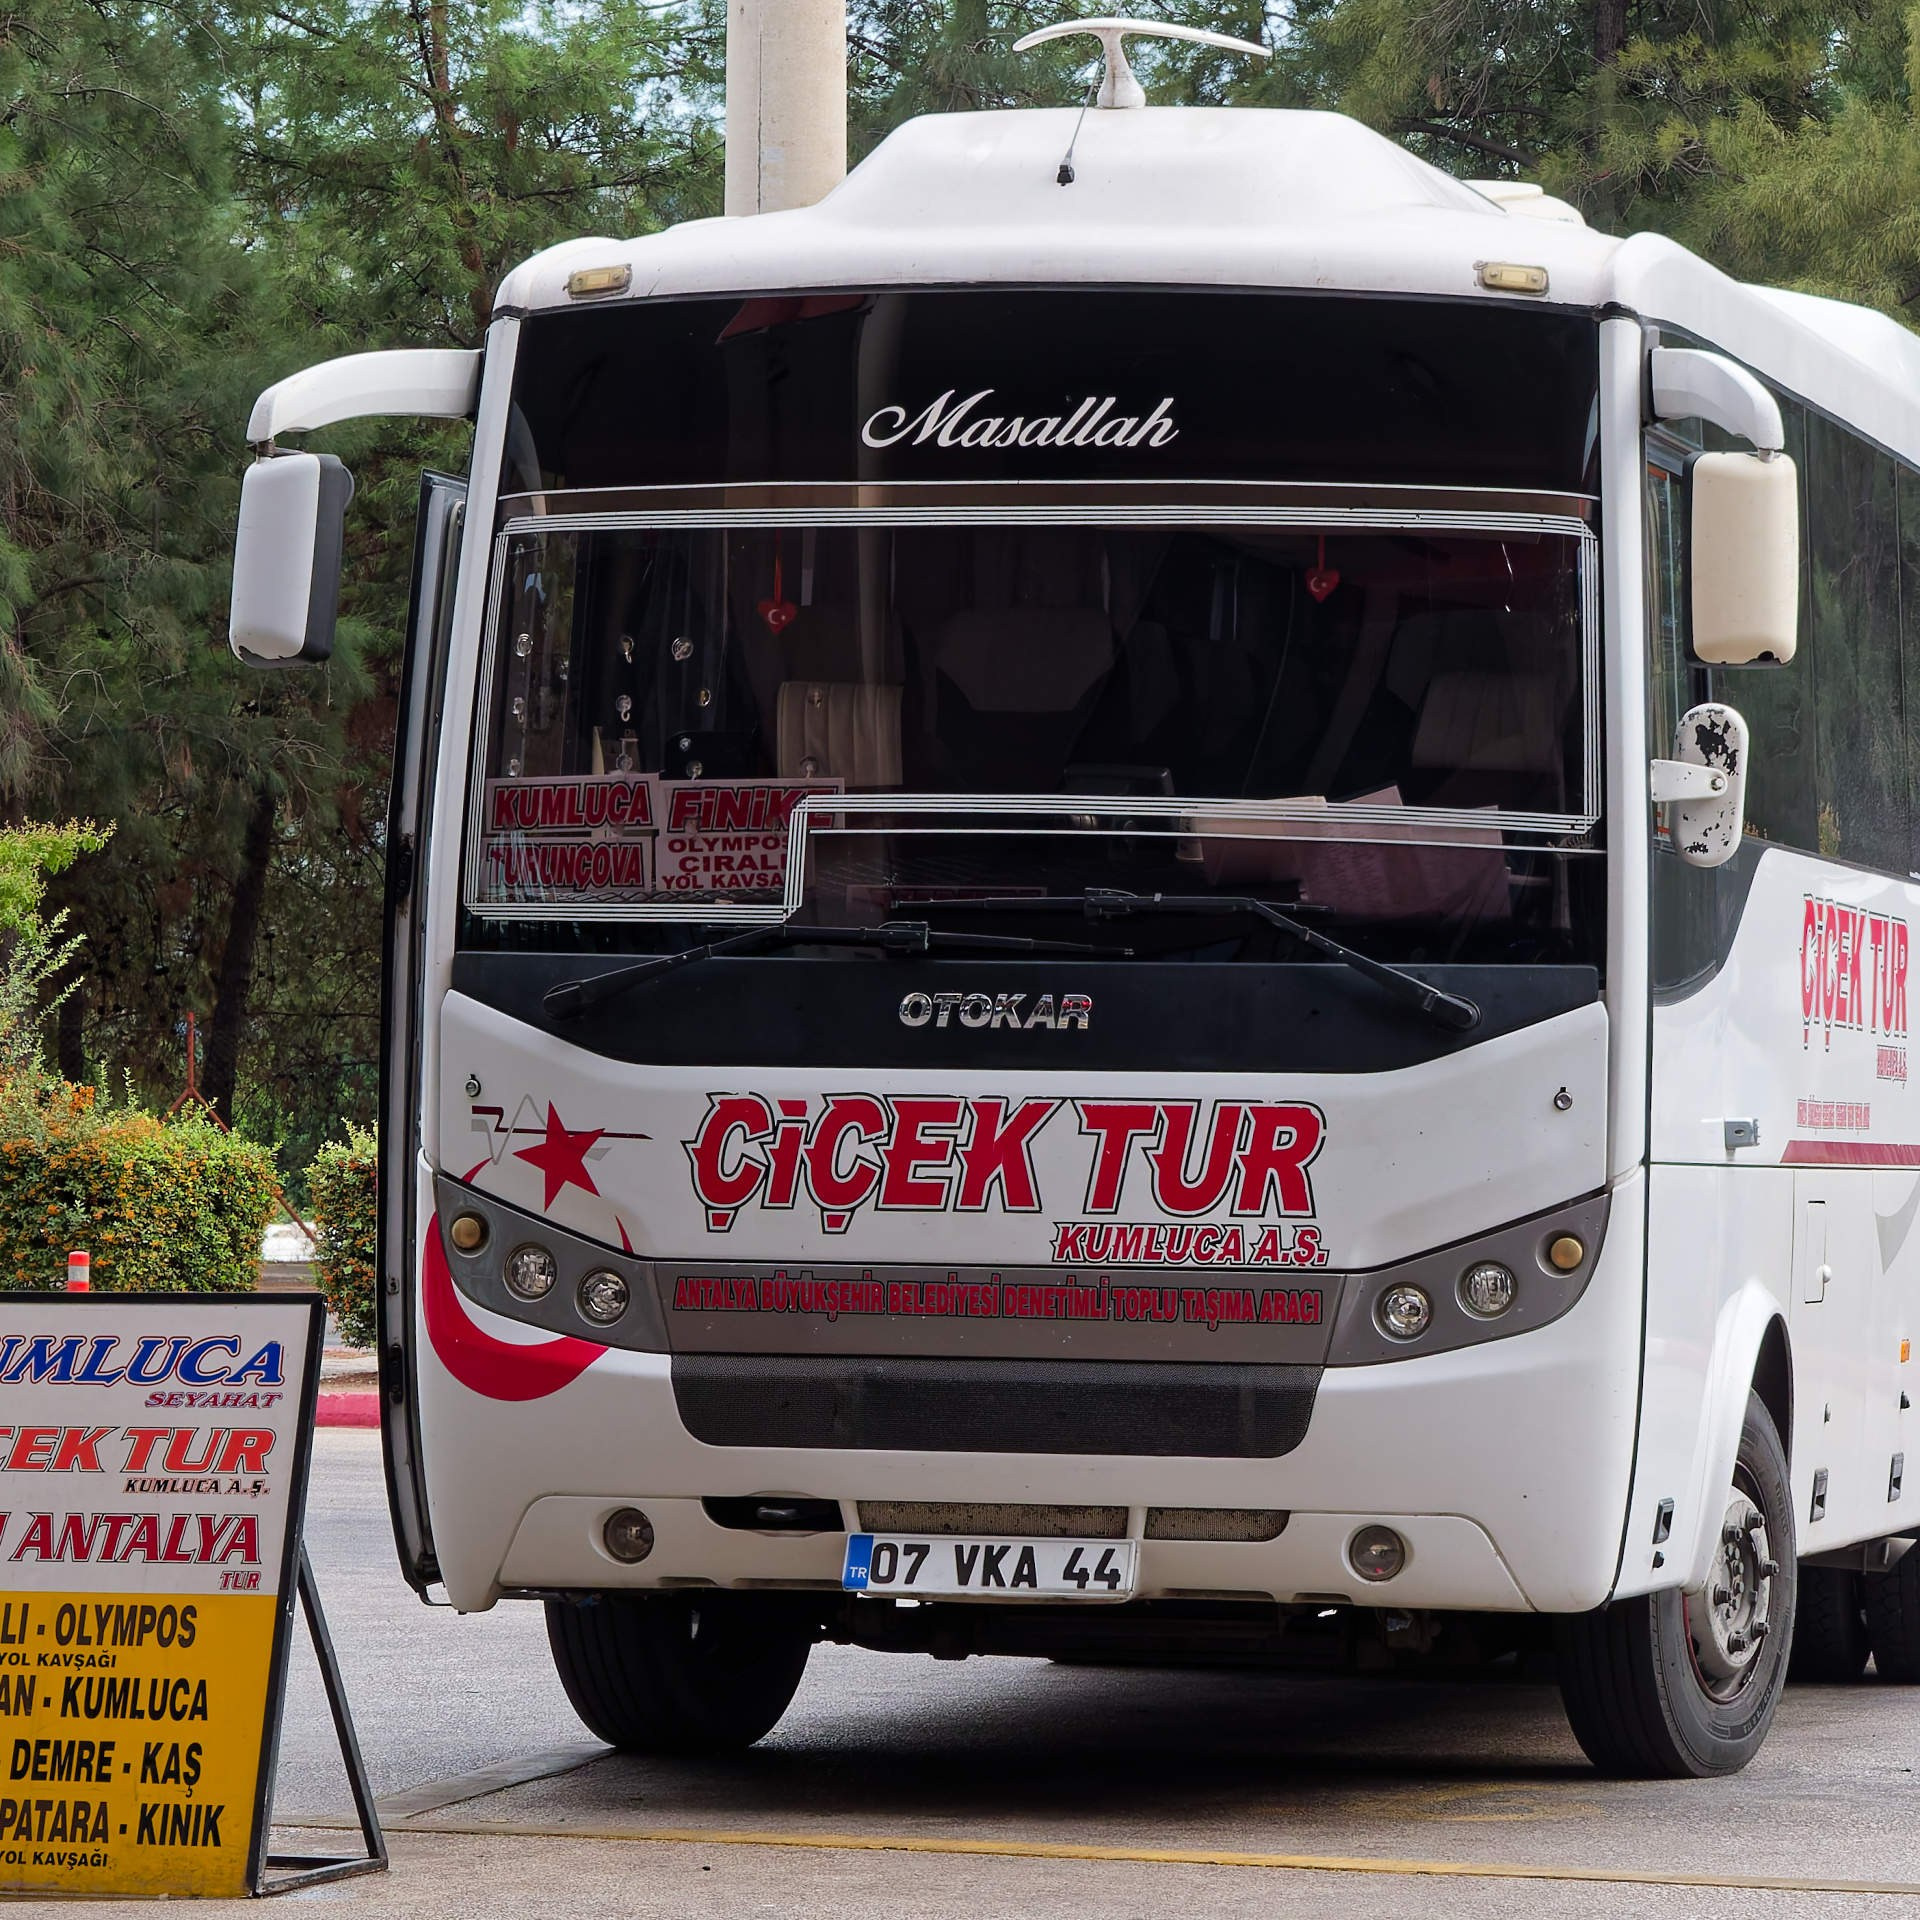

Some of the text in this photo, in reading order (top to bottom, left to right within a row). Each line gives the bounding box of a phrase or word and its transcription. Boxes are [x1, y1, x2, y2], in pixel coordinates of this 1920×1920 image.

[861, 389, 1179, 448] Masallah
[492, 781, 653, 830] KUMLUCA
[899, 992, 1093, 1029] OTOKAR
[1067, 1097, 1327, 1218] TUR
[1049, 1222, 1246, 1264] KUMLUCA
[674, 1277, 759, 1311] ANTALYA
[887, 1271, 1001, 1318] BELEDİYESİ
[1002, 1275, 1110, 1319] DENETİMLİ
[1113, 1286, 1178, 1321] TOPLU
[1181, 1288, 1257, 1331] TAŞIMA
[1256, 1290, 1323, 1324] ARACI
[144, 1391, 283, 1409] SEYAHAT
[120, 1427, 276, 1474] TUR
[123, 1478, 221, 1494] KUMLUCA
[8, 1512, 262, 1564] ANTALYA
[219, 1571, 261, 1590] TUR
[849, 1543, 1121, 1590] TR 07 VKA 44
[55, 1603, 197, 1648] OLYMPOS
[37, 1650, 117, 1671] KAVŞAĞI
[60, 1676, 208, 1721] KUMLUCA
[10, 1739, 203, 1798] DEMRE KAŞ
[0, 1799, 225, 1847] PATARA KINIK
[32, 1848, 108, 1872] KAVŞAĞI
